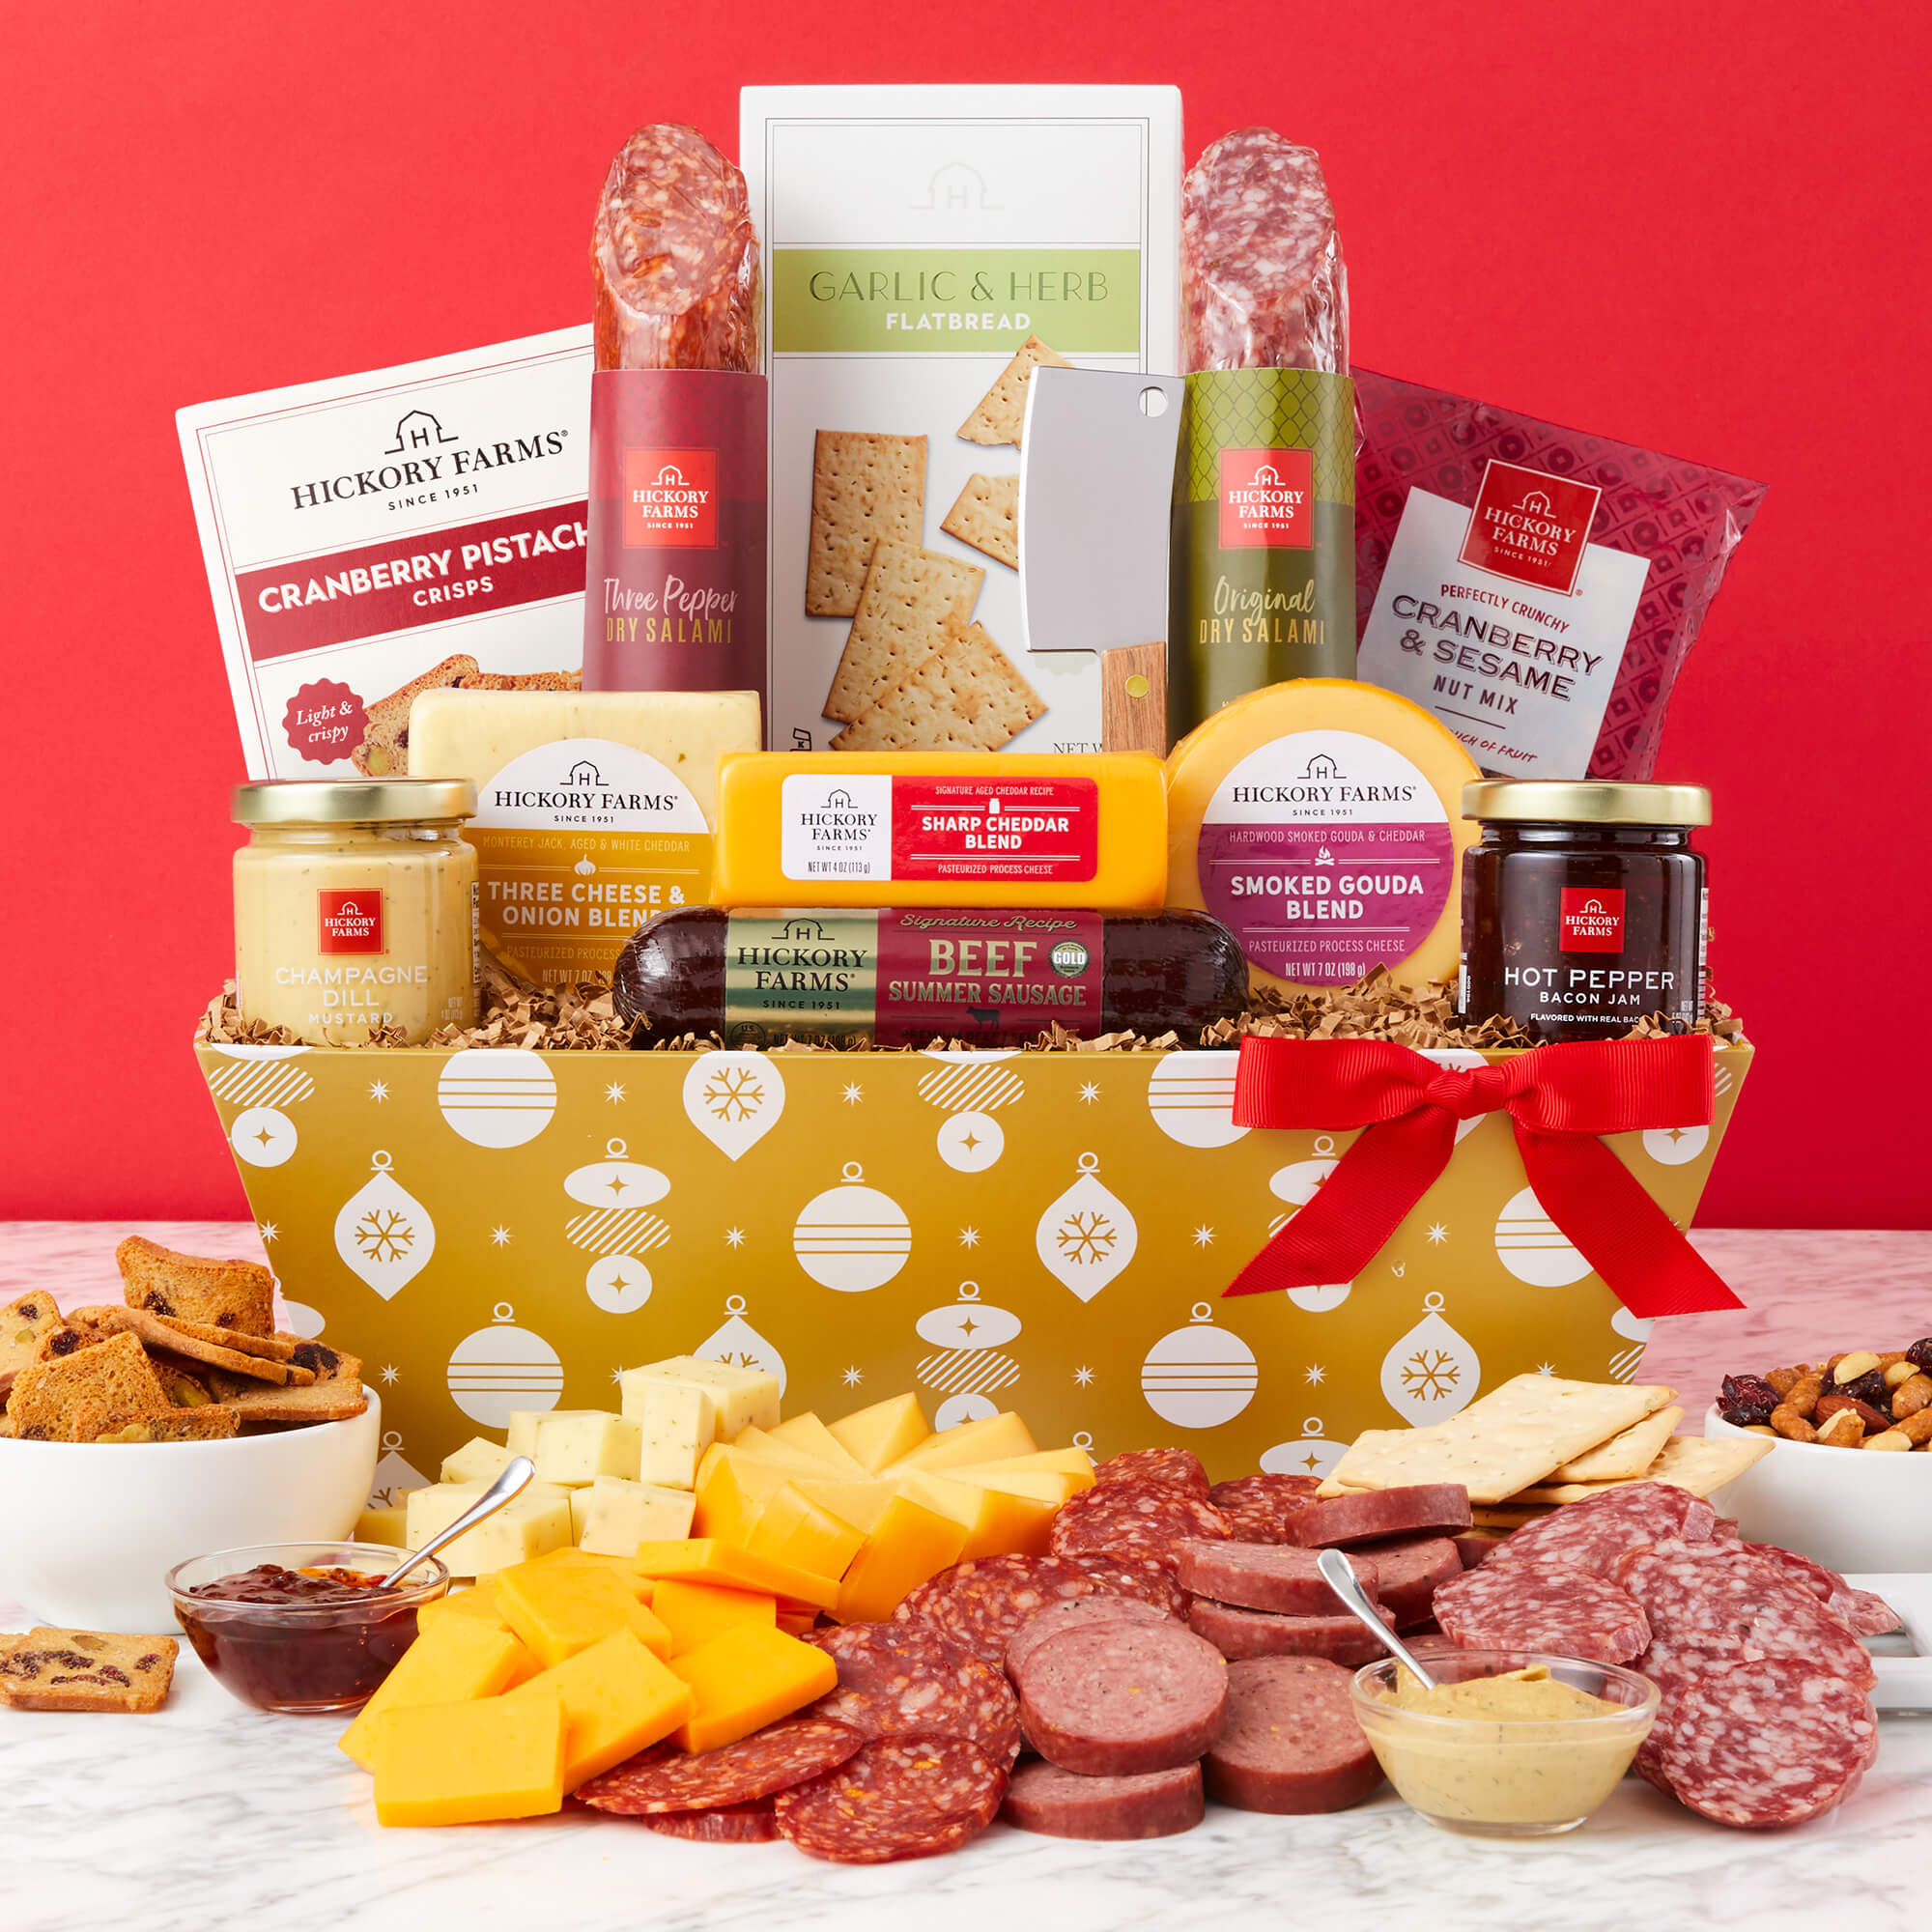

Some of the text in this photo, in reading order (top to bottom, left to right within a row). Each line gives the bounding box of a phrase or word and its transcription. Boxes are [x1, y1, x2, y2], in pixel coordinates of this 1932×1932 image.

[810, 271, 1108, 301] GARLIC & HERB
[886, 312, 1031, 330] FLATBREAD
[291, 456, 442, 509] HICKORY
[388, 484, 478, 510] SINCE 1951
[633, 490, 709, 503] HICKORY
[1229, 491, 1304, 504] HICKORY
[641, 505, 698, 518] FARMS
[1238, 505, 1293, 519] FARMS
[1484, 506, 1577, 543] HICKORY
[1492, 526, 1559, 555] FARMS
[1494, 547, 1523, 560] SINCE
[258, 550, 452, 612] CRANBERRY
[412, 576, 493, 606] CRISPS
[604, 574, 737, 621] Three Pepper
[1213, 575, 1316, 626] Original
[1441, 584, 1571, 634] PERFECTLY CRUNCHY
[607, 617, 731, 643] DRY SALAMI
[1199, 617, 1324, 644] DRY SALAMI
[1392, 595, 1604, 675] CRANBERRY
[1400, 629, 1576, 701] & SESAME
[1434, 675, 1519, 714] NUT MIX
[296, 700, 354, 726] Light &
[309, 725, 348, 744] crispy
[1450, 728, 1538, 762] UCH OF FRUIT
[935, 785, 1054, 796] SIGNATURE AGED CHEDDAR RECIPE
[1233, 785, 1412, 803] HICKORY FARMS
[494, 791, 674, 810] HICKORY FARMS
[801, 813, 878, 826] HICKORY
[922, 816, 1069, 832] SHARP CHEDDAR
[483, 835, 534, 850] MONTEREY
[570, 838, 596, 850] AGED
[600, 839, 608, 850] &
[611, 839, 640, 851] WHITE
[644, 840, 690, 852] CHEDDAR
[811, 829, 867, 840] FARMS
[966, 834, 1022, 849] BLEND
[1229, 830, 1425, 843] HARDWOOD SMOKED GOUDA & CHEDDAR
[808, 862, 819, 872] NET
[821, 862, 832, 872] WT
[833, 862, 838, 872] 4
[838, 862, 847, 872] OZ
[938, 864, 1053, 874] PASTEURIZED PROCESS CHEESE
[488, 881, 685, 905] THREE CHEESE &
[1231, 875, 1424, 895] SMOKED GOUDA
[502, 906, 580, 926] ONION
[1287, 899, 1364, 920] BLEND
[325, 918, 376, 927] HICKORY
[899, 914, 1077, 932] Signature Recipe
[1566, 916, 1620, 926] HICKORY
[332, 927, 369, 937] FARMS
[1573, 926, 1612, 936] FARMS
[507, 945, 575, 959] PASTEURIZED
[1249, 939, 1405, 952] PASTEURIZED PROCESS CHEESE
[738, 948, 867, 967] HICKORY
[928, 939, 1037, 978] BEEF
[1053, 952, 1086, 965] GOLD
[275, 966, 428, 984] CHAMPAGNE
[1285, 962, 1366, 978] NET WT 7 OZ (198 g)
[1505, 967, 1674, 989] HOT PEPPER
[755, 971, 849, 992] FARMS
[324, 989, 379, 1007] DILL
[889, 980, 1087, 1006] SUMMER SAUSAGE
[1540, 991, 1640, 1005] BACON JAM
[763, 1000, 840, 1009] SINCE 1951
[308, 1012, 393, 1024] MUSTARD
[1530, 1013, 1575, 1022] FLAVORED
